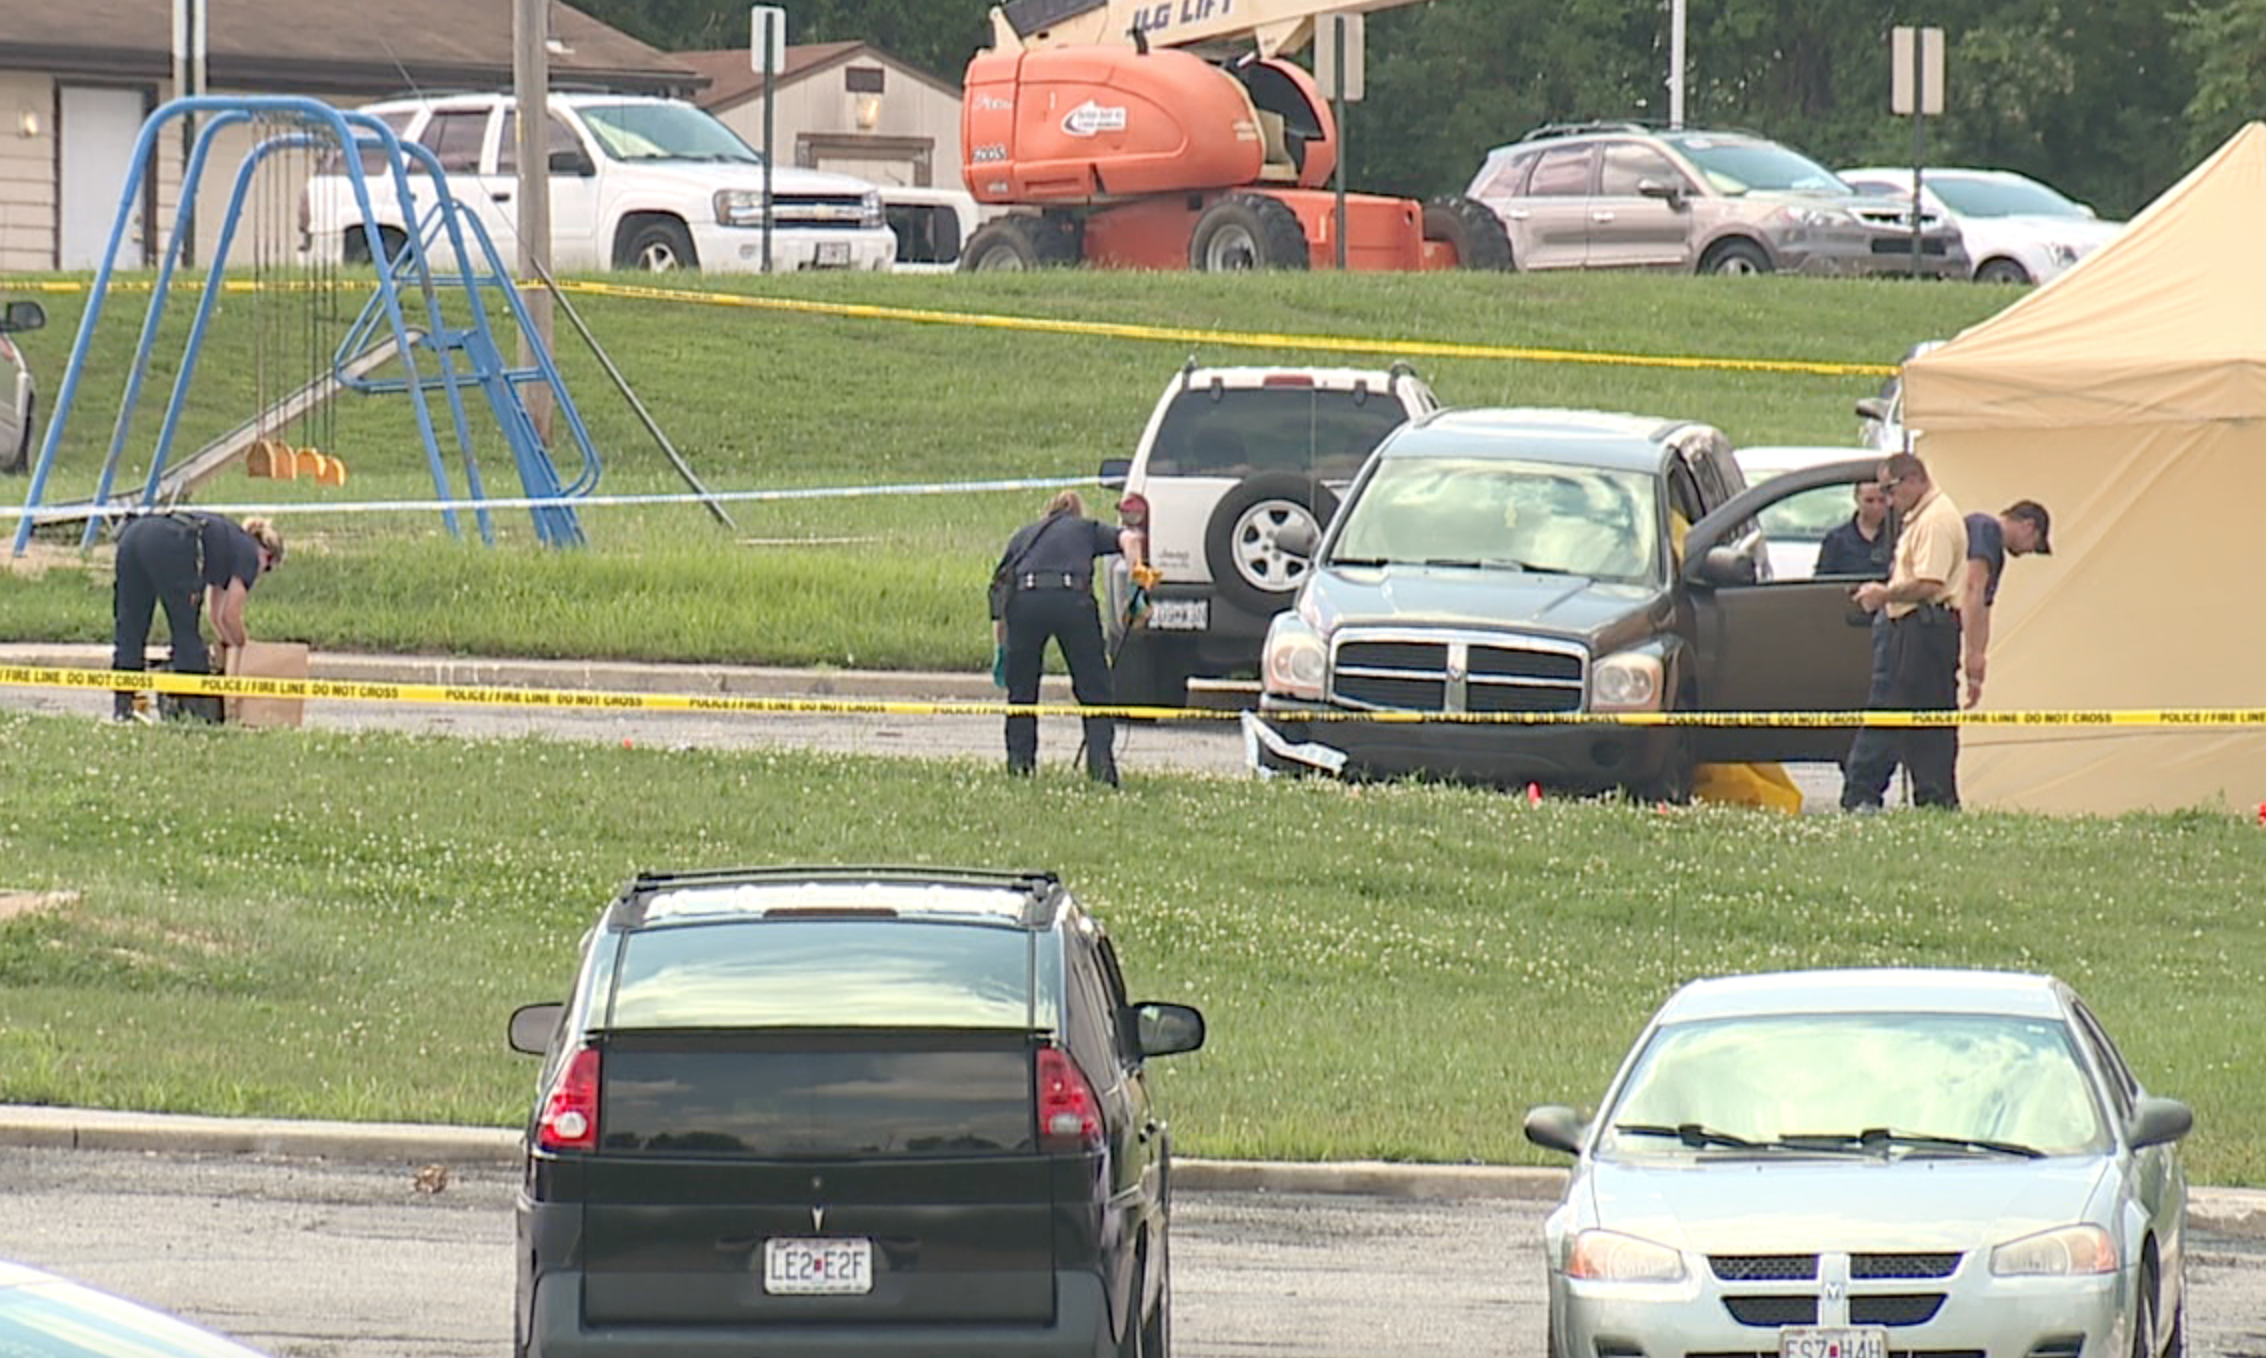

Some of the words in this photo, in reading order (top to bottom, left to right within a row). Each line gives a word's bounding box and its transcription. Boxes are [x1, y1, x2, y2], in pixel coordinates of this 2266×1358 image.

[34, 671, 60, 683] LINE
[66, 672, 84, 684] DO
[87, 673, 111, 686] NOT
[114, 675, 153, 688] CROSS
[279, 682, 306, 694] LINE
[311, 684, 328, 695] DO
[332, 685, 355, 697] NOT
[358, 686, 398, 698] CROSS
[524, 692, 550, 704] LINE
[556, 694, 572, 705] DO
[576, 695, 599, 706] NOT
[603, 696, 643, 707] CROSS
[1991, 713, 2018, 723] LINE
[2024, 713, 2042, 723] DO
[2045, 713, 2069, 723] NOT
[2072, 713, 2112, 723] CROSS
[2239, 712, 2266, 722] LINE
[771, 1251, 812, 1280] LE2
[824, 1251, 865, 1279] E2F
